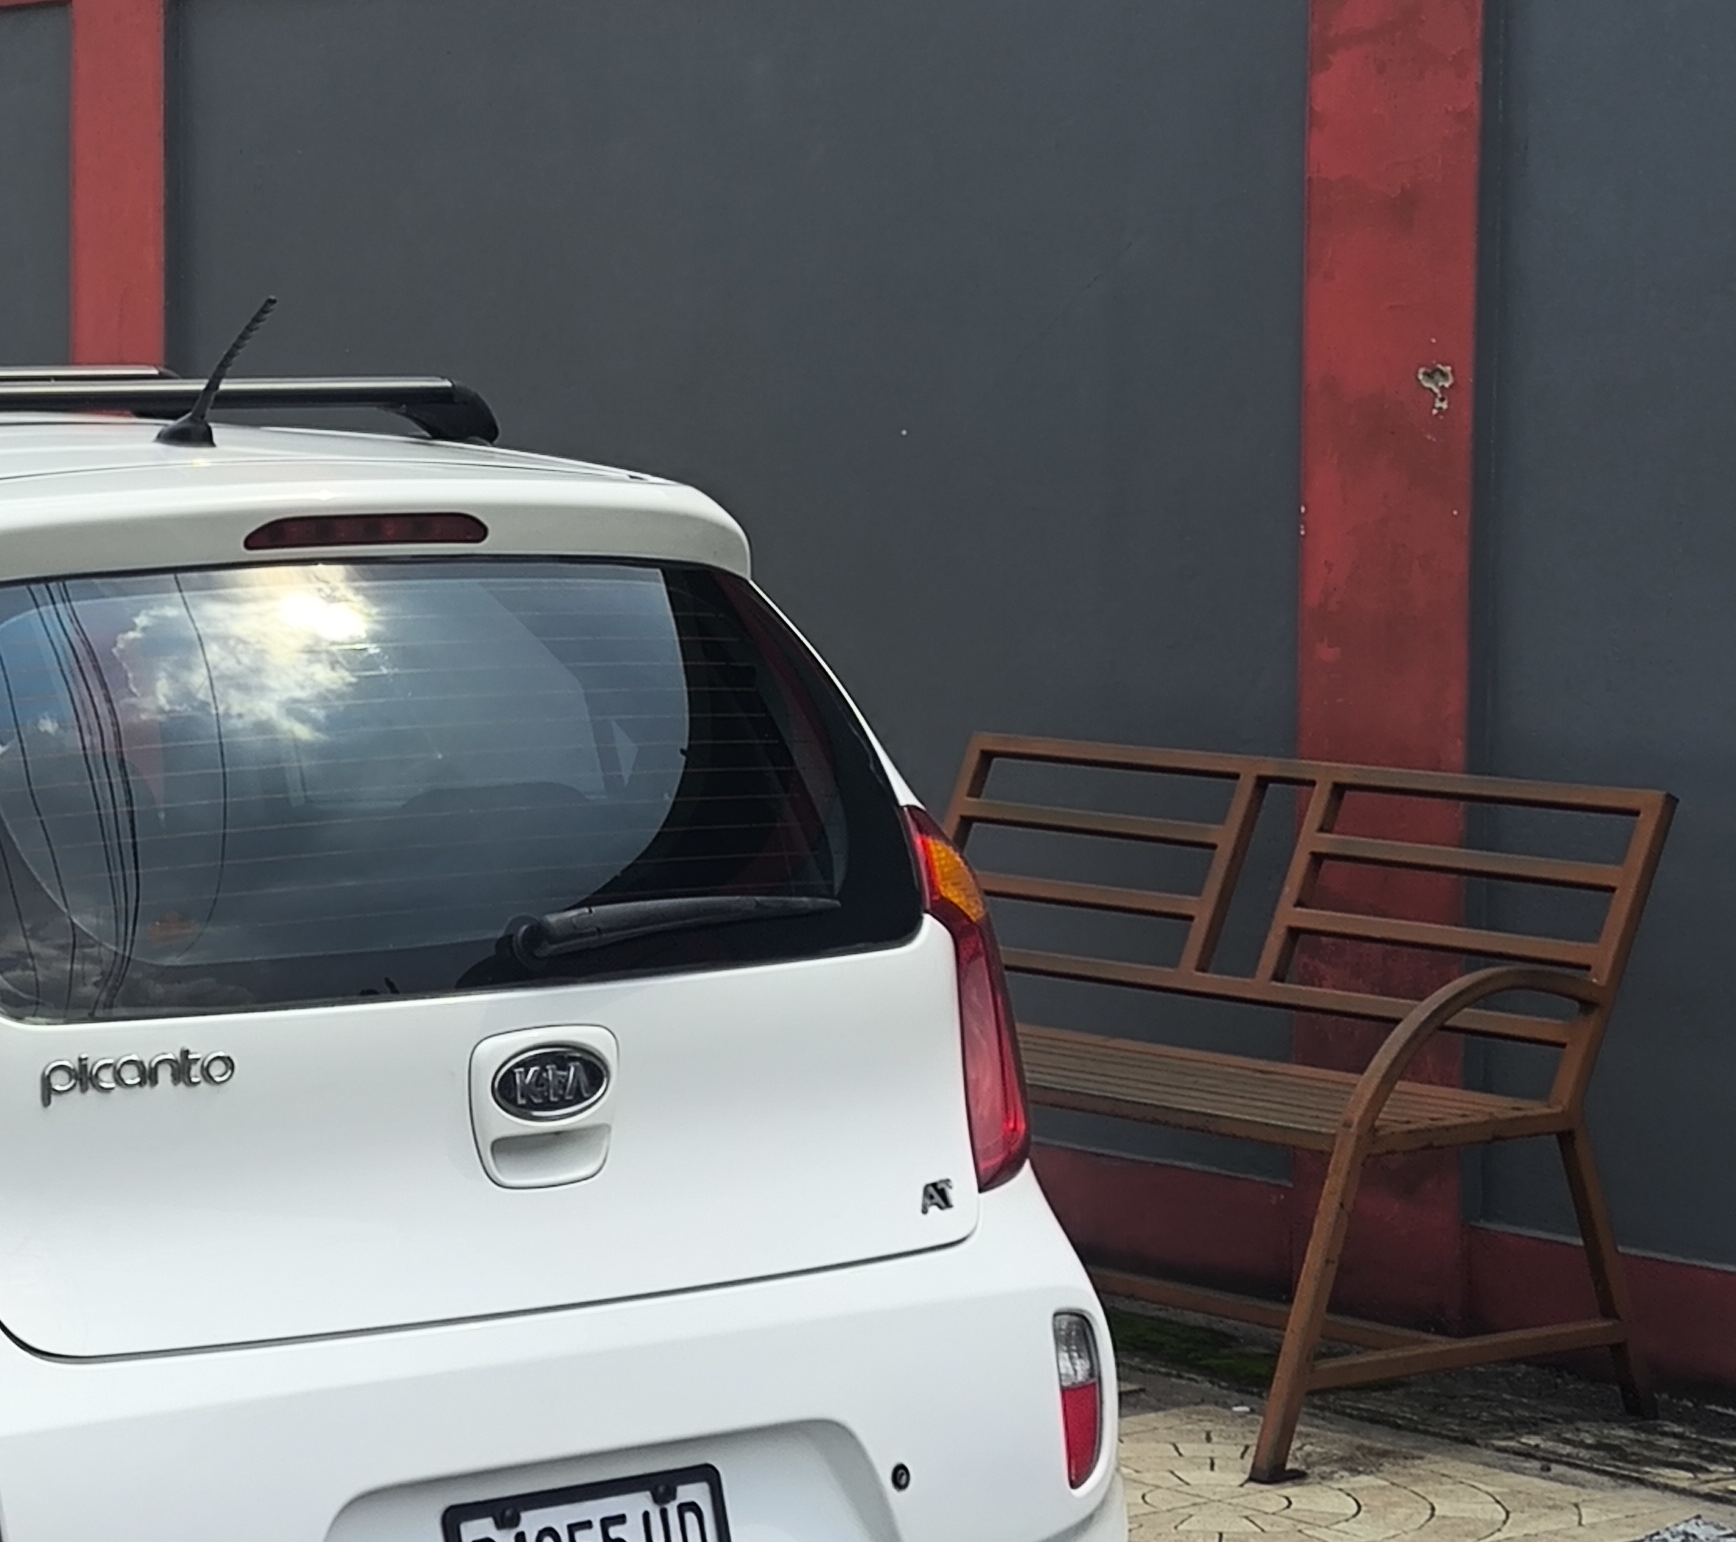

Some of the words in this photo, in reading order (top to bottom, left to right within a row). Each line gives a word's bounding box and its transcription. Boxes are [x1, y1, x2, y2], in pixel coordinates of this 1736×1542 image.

[40, 1045, 236, 1109] picanto
[512, 1060, 592, 1105] KIA
[921, 1177, 954, 1215] AT
